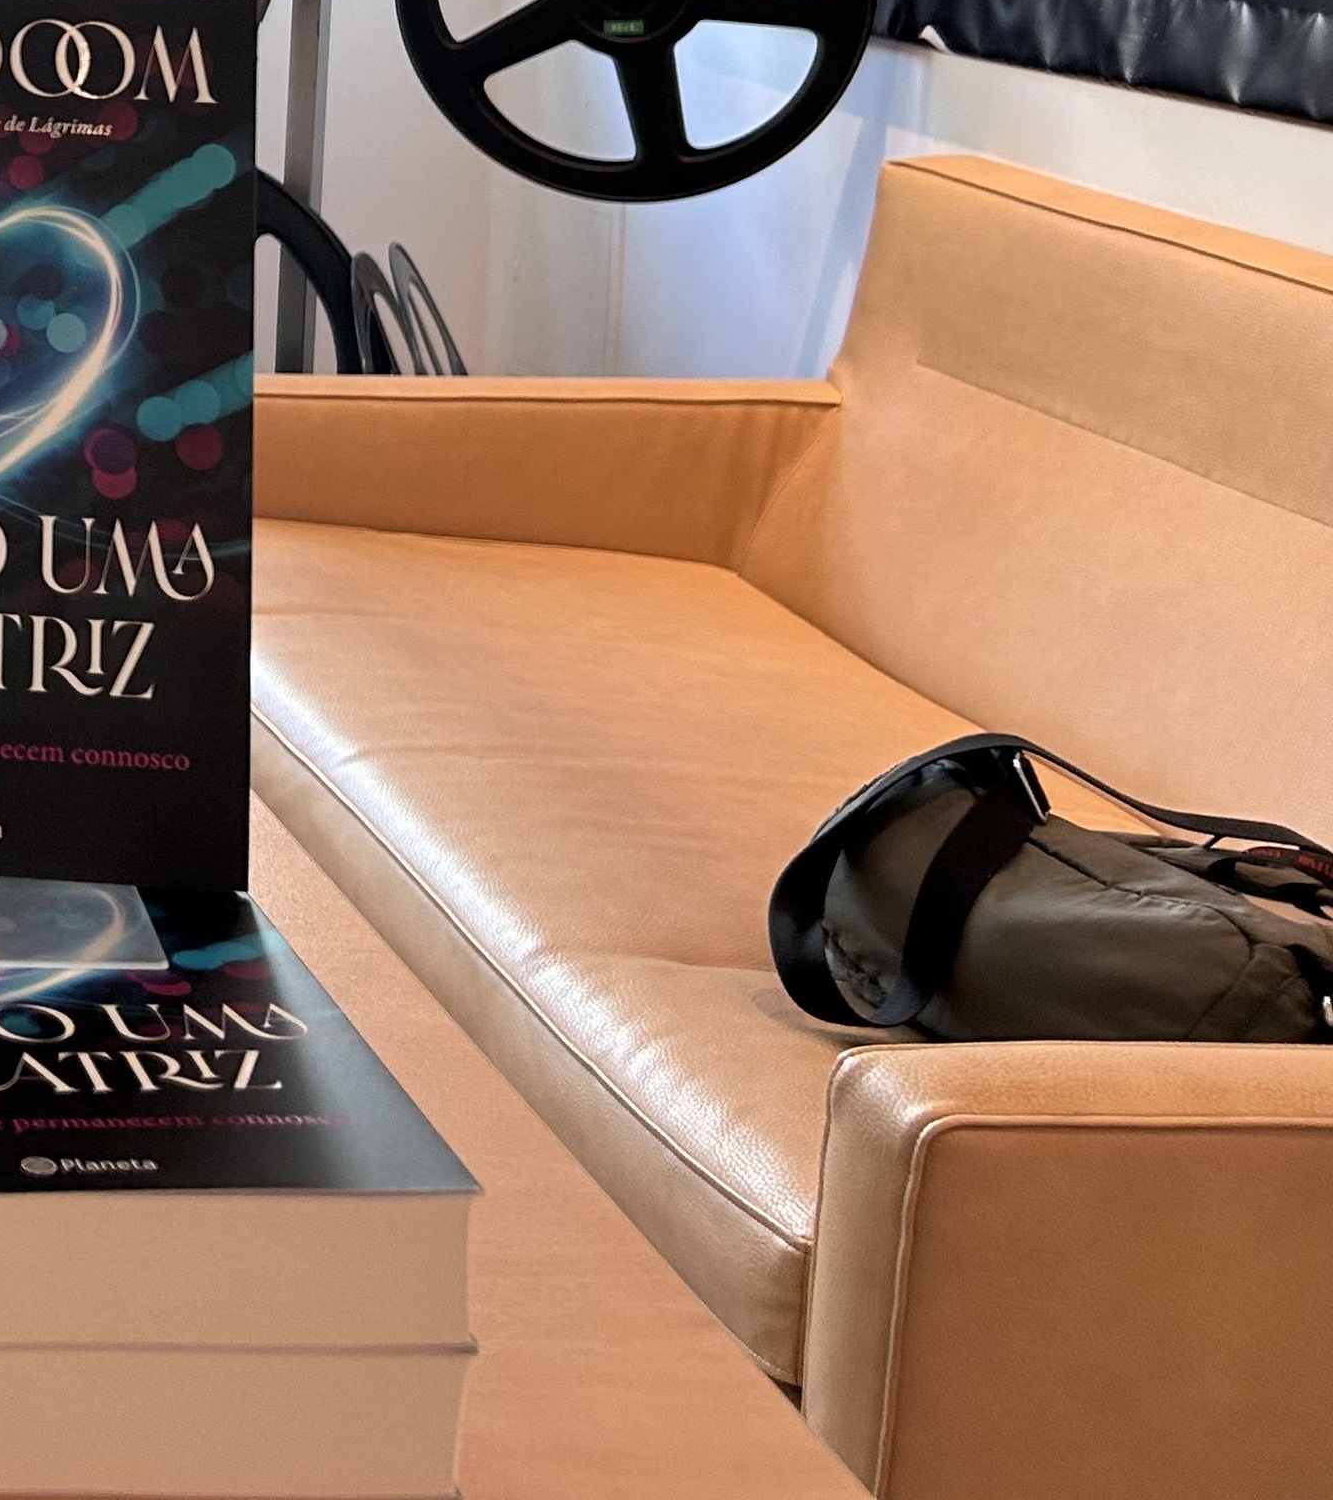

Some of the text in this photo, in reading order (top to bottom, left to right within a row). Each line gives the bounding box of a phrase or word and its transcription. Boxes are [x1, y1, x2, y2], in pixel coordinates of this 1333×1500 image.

[3, 116, 25, 133] de
[27, 114, 113, 138] Lágrimas
[37, 514, 217, 601] UMA
[69, 746, 191, 771] connosco
[102, 1002, 310, 1042] UMA
[11, 1112, 206, 1136] permanecem
[60, 1156, 160, 1174] Planeta
